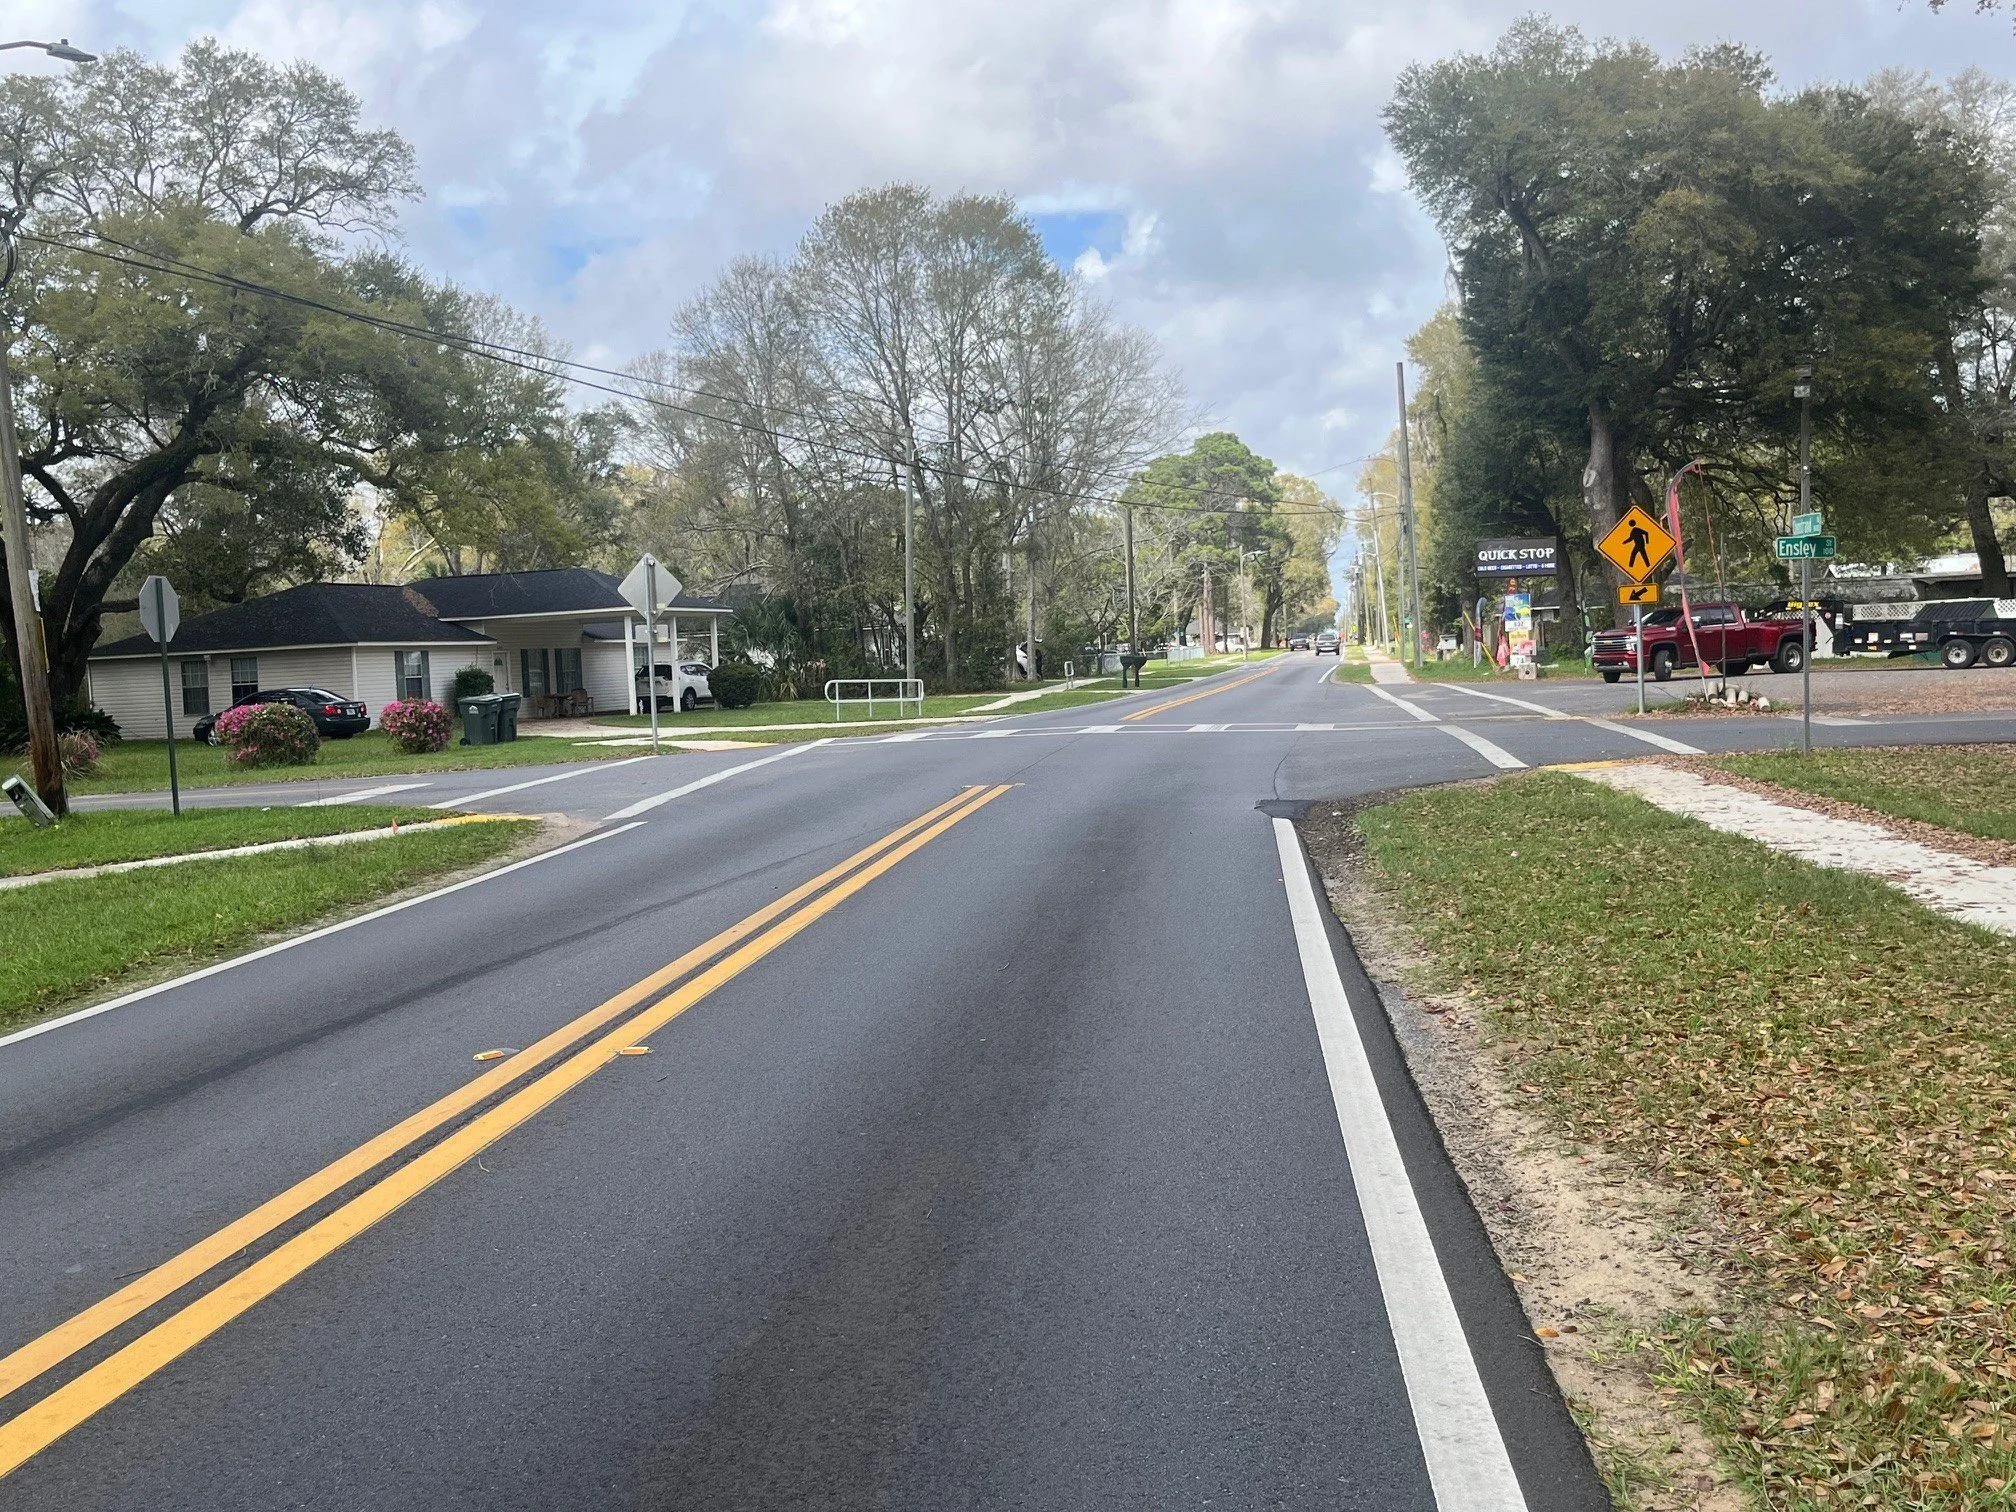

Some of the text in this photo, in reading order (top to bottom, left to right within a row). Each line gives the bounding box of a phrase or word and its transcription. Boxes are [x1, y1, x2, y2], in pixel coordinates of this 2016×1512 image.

[1478, 549, 1518, 561] QUICK
[1519, 547, 1555, 559] STOP
[1779, 540, 1816, 557] Ensley
